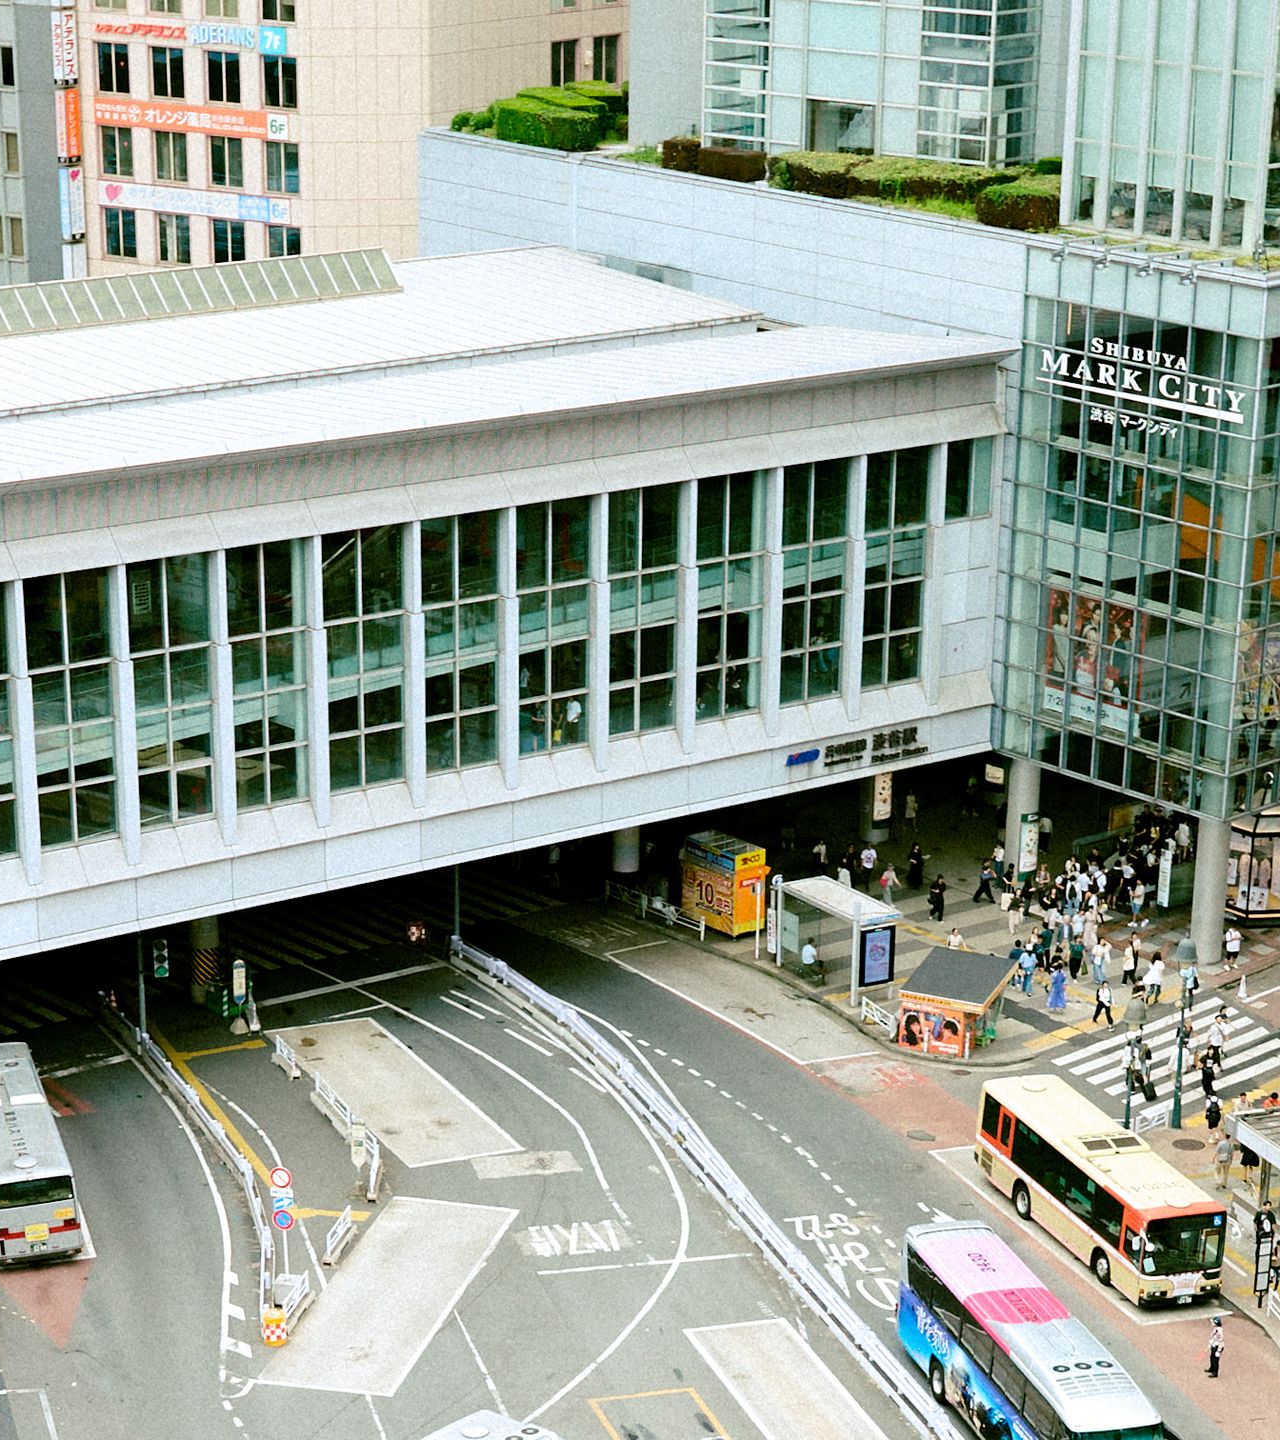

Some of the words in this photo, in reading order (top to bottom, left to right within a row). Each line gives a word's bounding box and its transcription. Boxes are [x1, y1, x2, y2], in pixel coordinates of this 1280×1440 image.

[64, 13, 76, 76] アデランス
[191, 25, 255, 48] ADERANS
[264, 32, 280, 49] 7F
[270, 119, 286, 135] 6F
[1091, 337, 1188, 371] SHIBUYA
[1040, 349, 1142, 392] MARK
[1158, 374, 1247, 413] CITY
